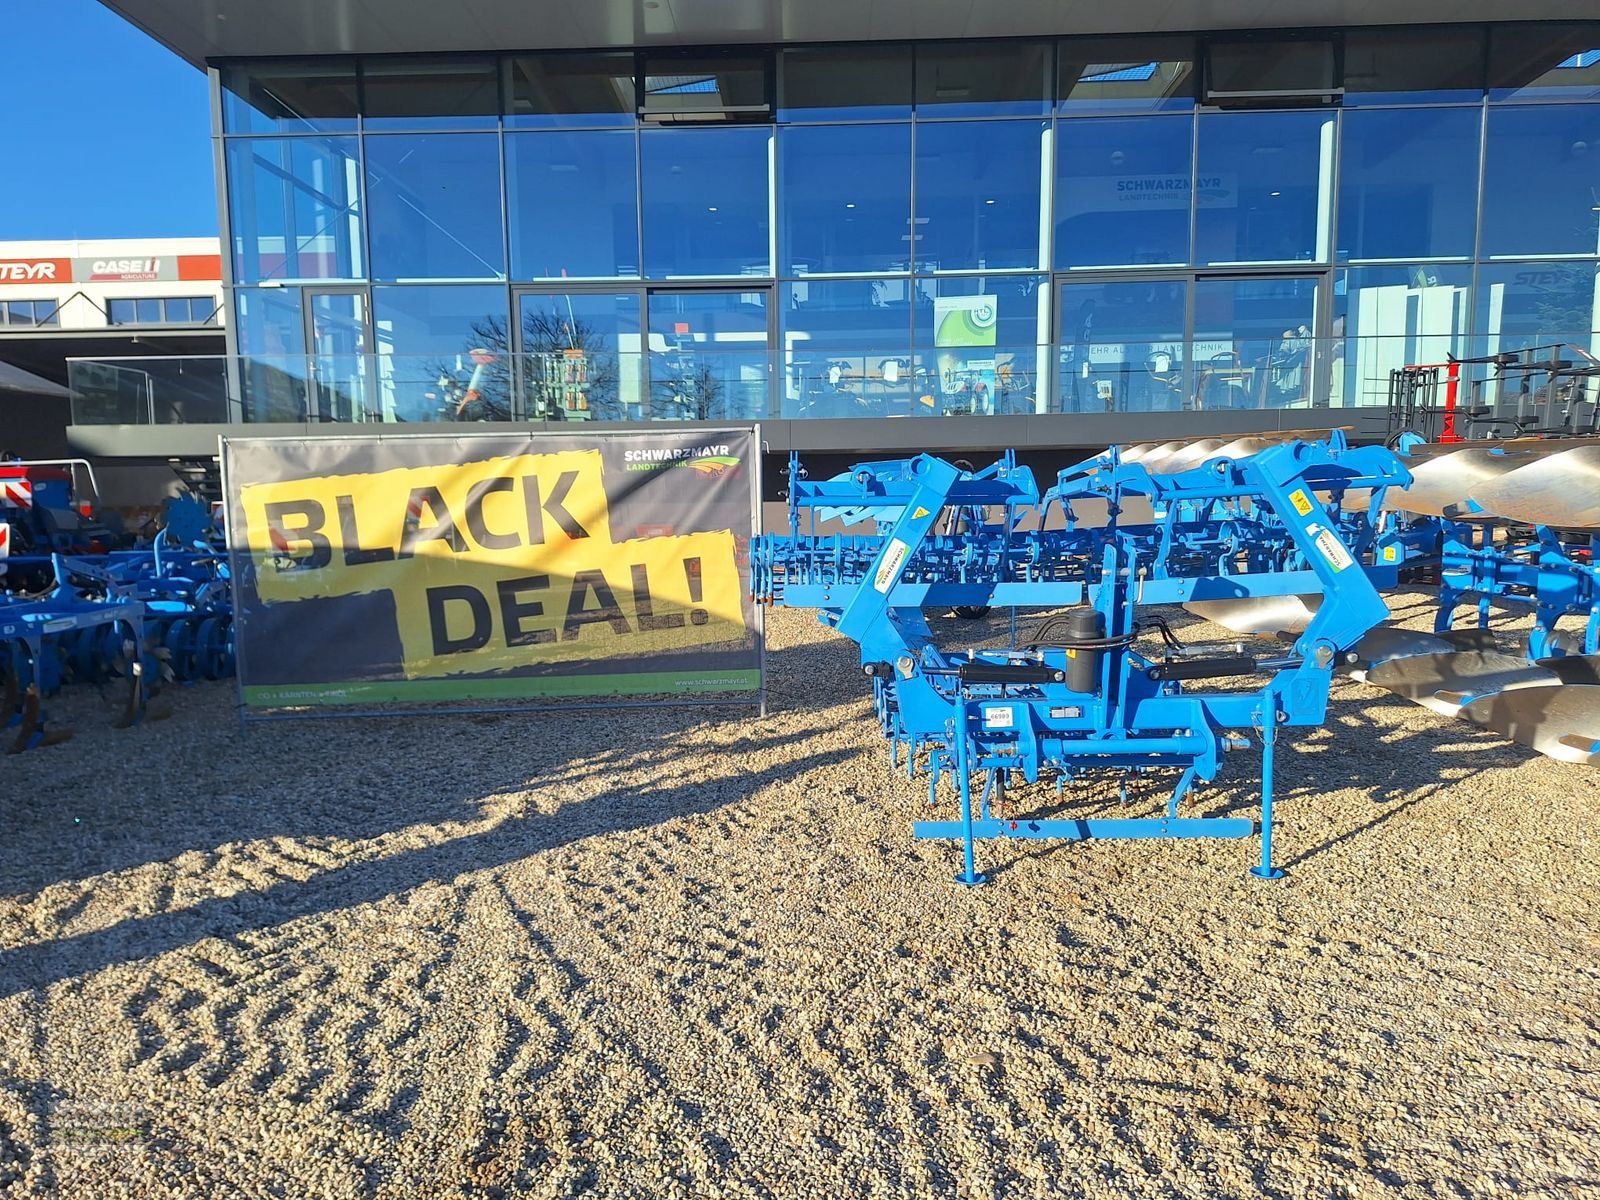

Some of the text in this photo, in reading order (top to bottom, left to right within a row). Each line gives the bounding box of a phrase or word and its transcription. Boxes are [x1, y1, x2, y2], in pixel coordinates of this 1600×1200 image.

[0, 262, 56, 280] TEYR
[92, 260, 143, 273] CASE
[1090, 346, 1109, 355] EHR
[624, 445, 730, 461] SCHWARZMAYR
[626, 460, 688, 471] LANDTECHNIK
[265, 470, 590, 573] BLACK
[426, 557, 709, 656] DEAL!
[675, 677, 748, 687] www.schwarzmayr.at
